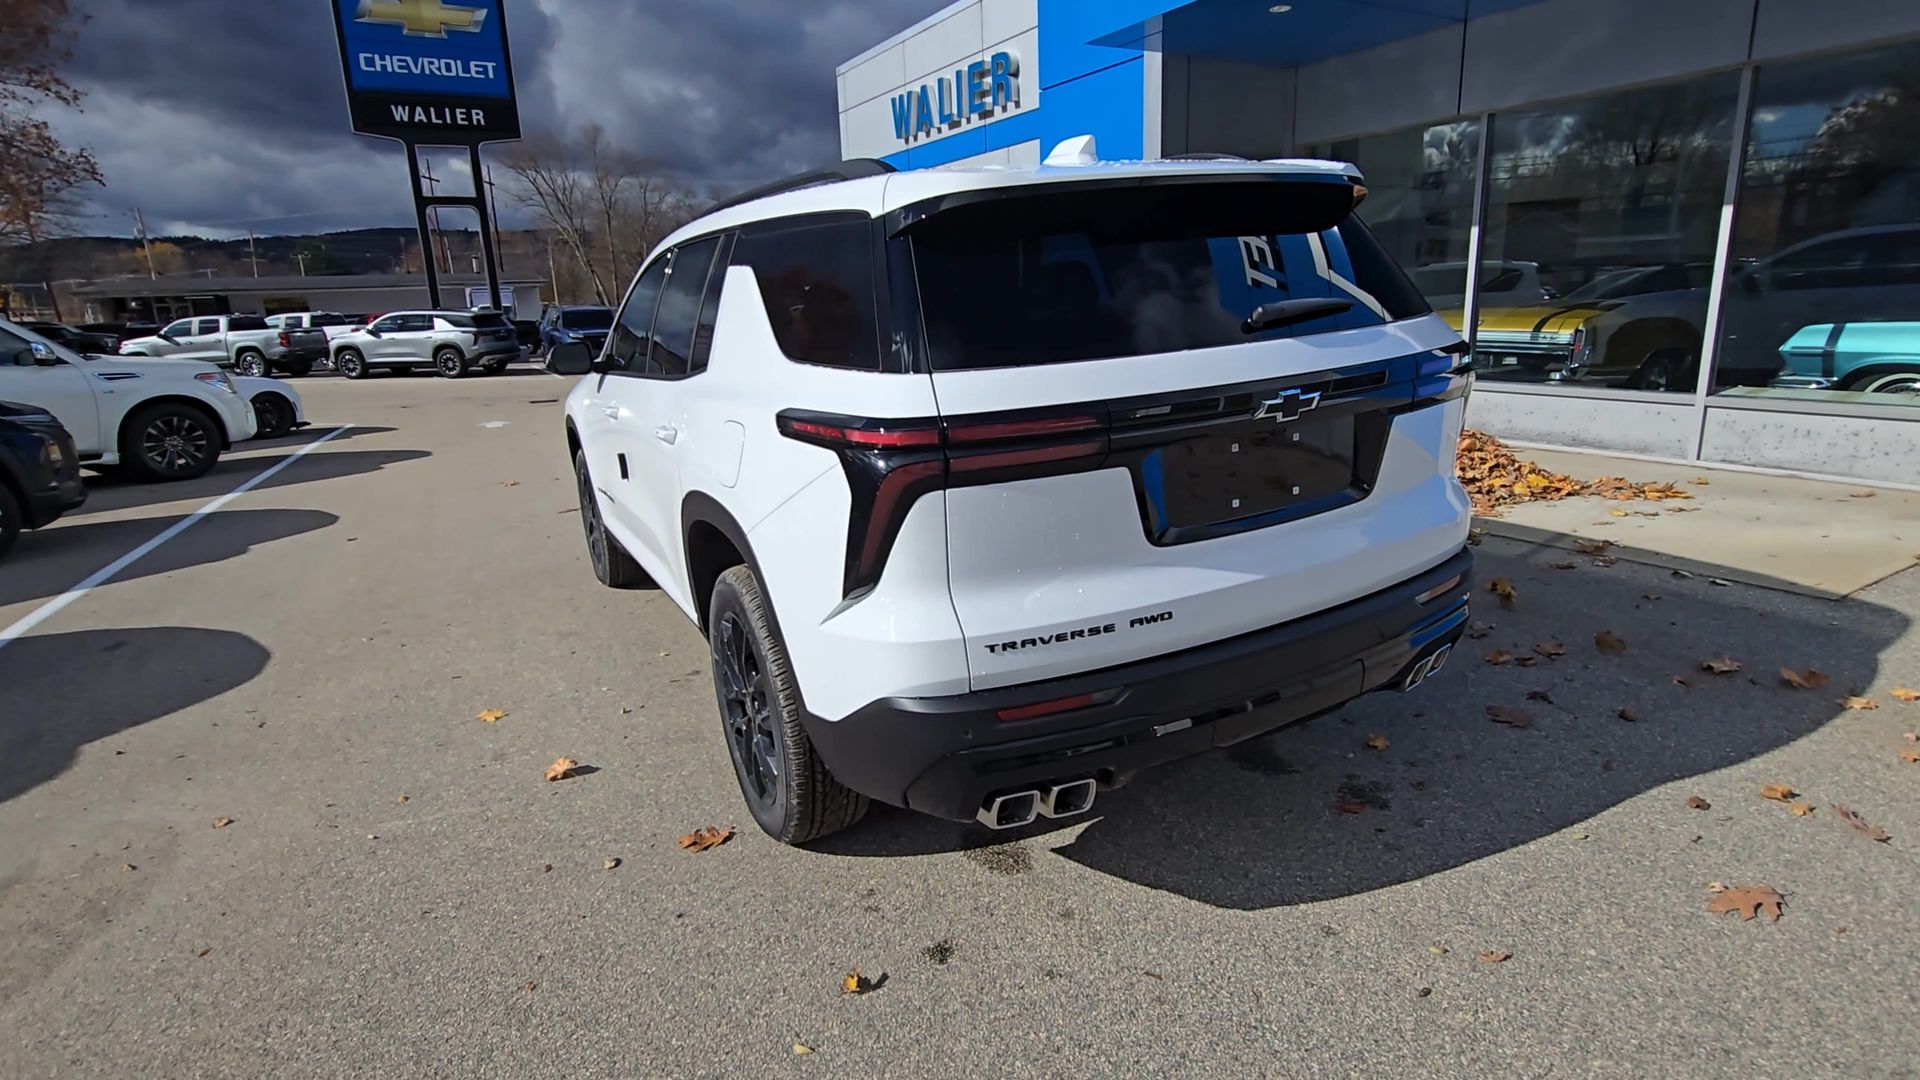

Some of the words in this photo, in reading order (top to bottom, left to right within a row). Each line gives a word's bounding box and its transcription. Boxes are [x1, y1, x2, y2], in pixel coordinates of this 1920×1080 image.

[358, 53, 496, 78] CHEVROLET
[891, 51, 1017, 139] WALIER
[390, 104, 485, 125] WALIER
[984, 623, 1116, 653] TRAVERSE
[1129, 611, 1173, 628] AWD
